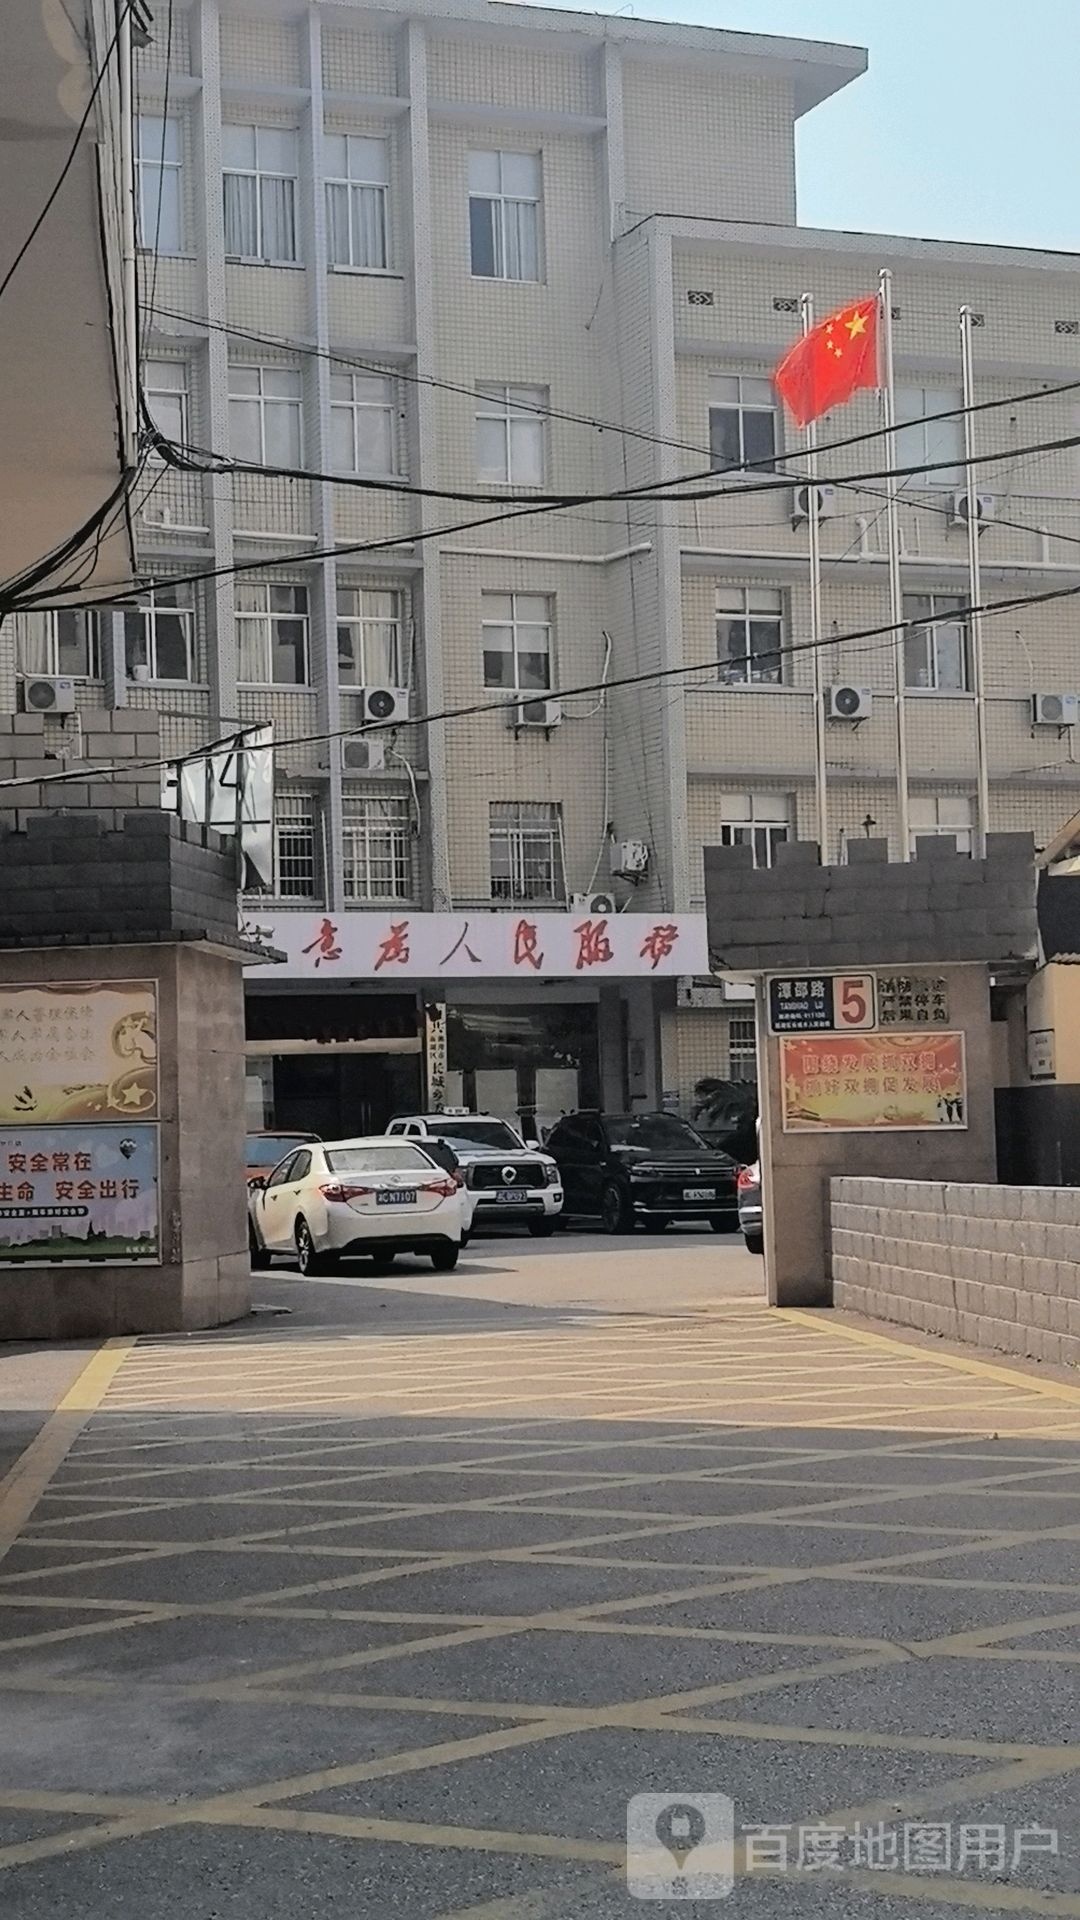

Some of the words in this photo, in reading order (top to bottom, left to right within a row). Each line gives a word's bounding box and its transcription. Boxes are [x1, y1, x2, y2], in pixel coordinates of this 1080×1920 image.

[841, 980, 867, 1024] 5
[881, 993, 946, 1008] 严禁停车
[881, 1008, 946, 1022] 后果自负
[8, 1151, 92, 1173] 安全常在
[0, 1181, 35, 1201] 生命
[55, 1178, 140, 1201] 安全出行
